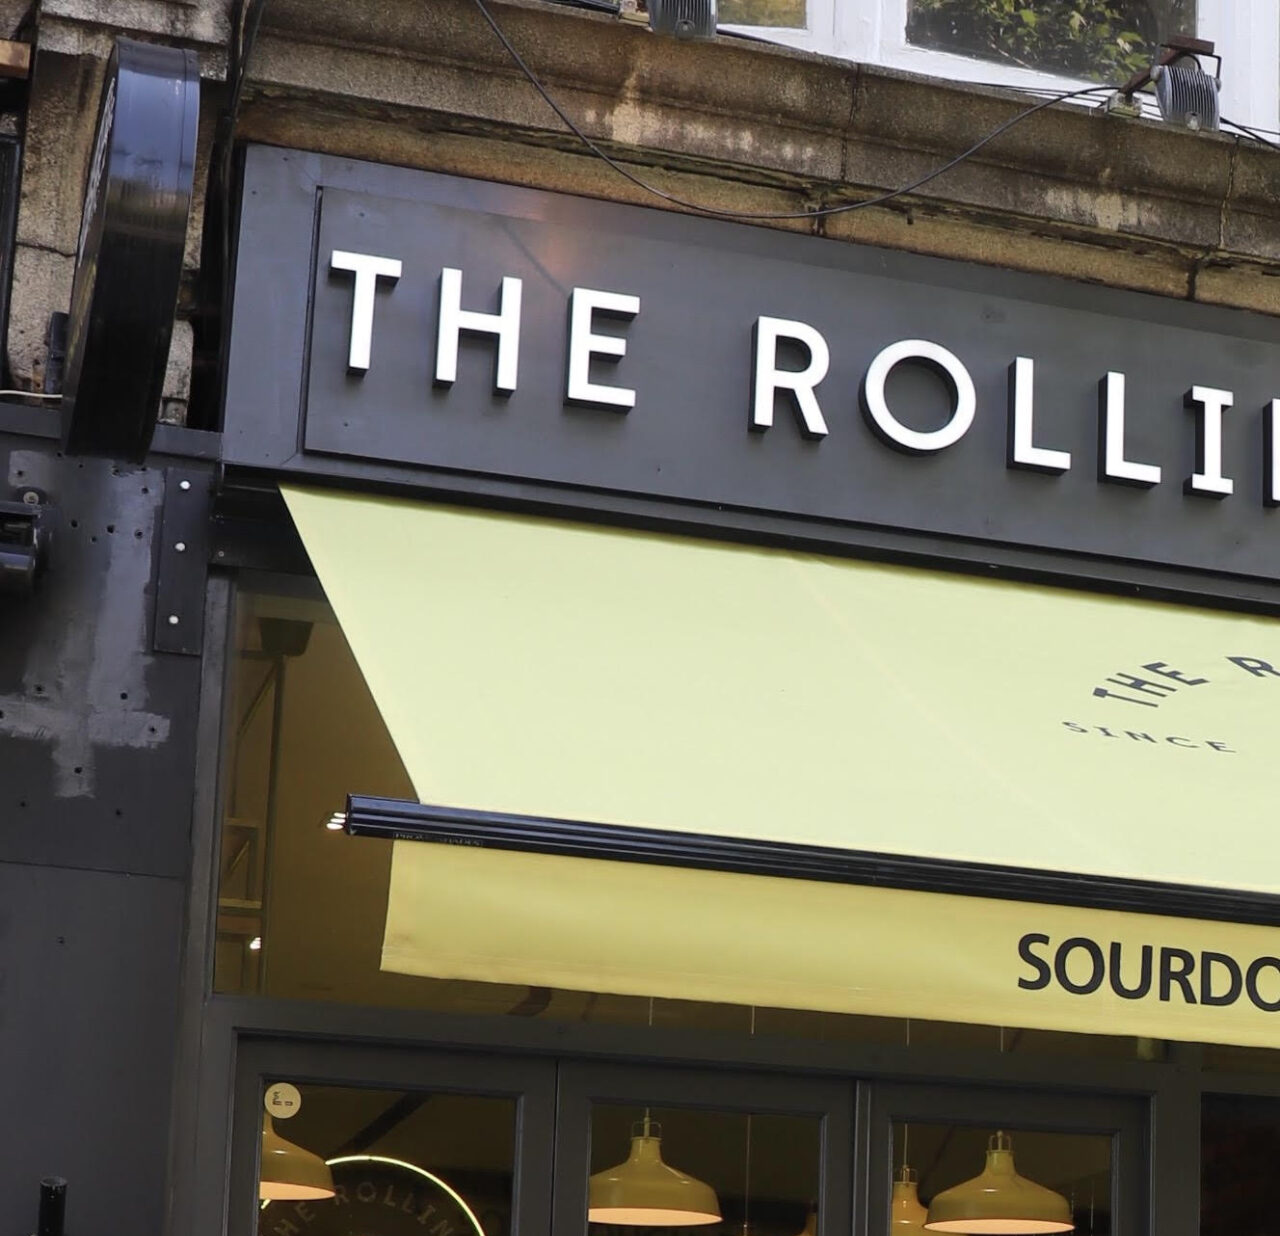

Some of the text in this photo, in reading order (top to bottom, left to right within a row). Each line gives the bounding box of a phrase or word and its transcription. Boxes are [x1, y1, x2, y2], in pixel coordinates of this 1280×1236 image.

[330, 250, 641, 412] THE
[1092, 661, 1211, 709] THE
[1061, 721, 1239, 756] SINCE
